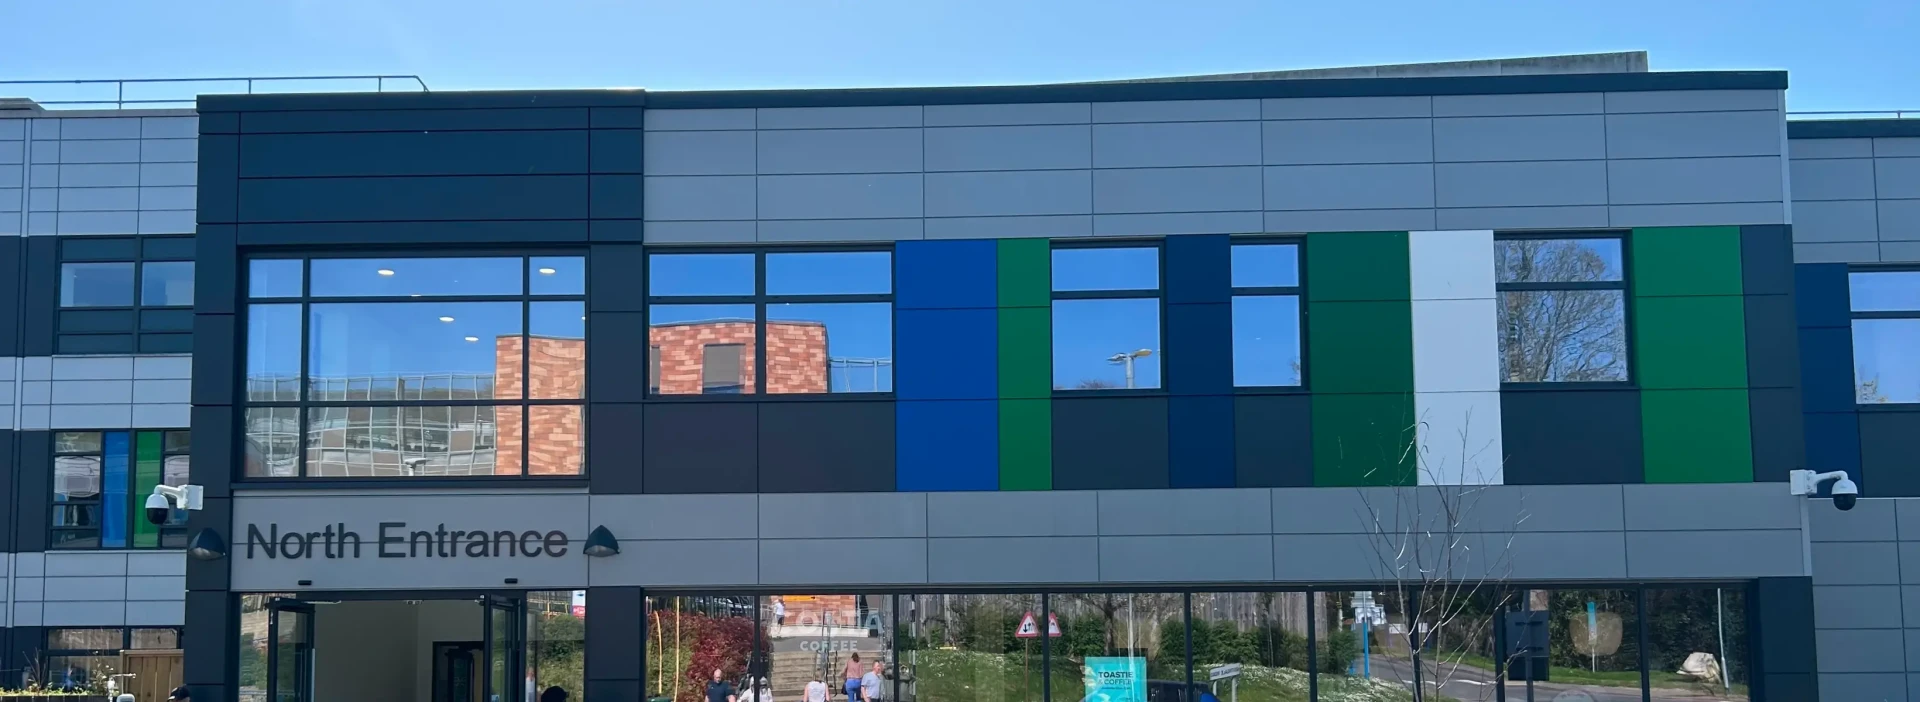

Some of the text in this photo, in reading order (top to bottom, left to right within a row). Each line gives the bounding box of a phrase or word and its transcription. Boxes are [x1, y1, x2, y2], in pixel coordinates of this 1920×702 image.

[247, 522, 568, 559] North Entrance
[800, 640, 858, 652] COFFEE
